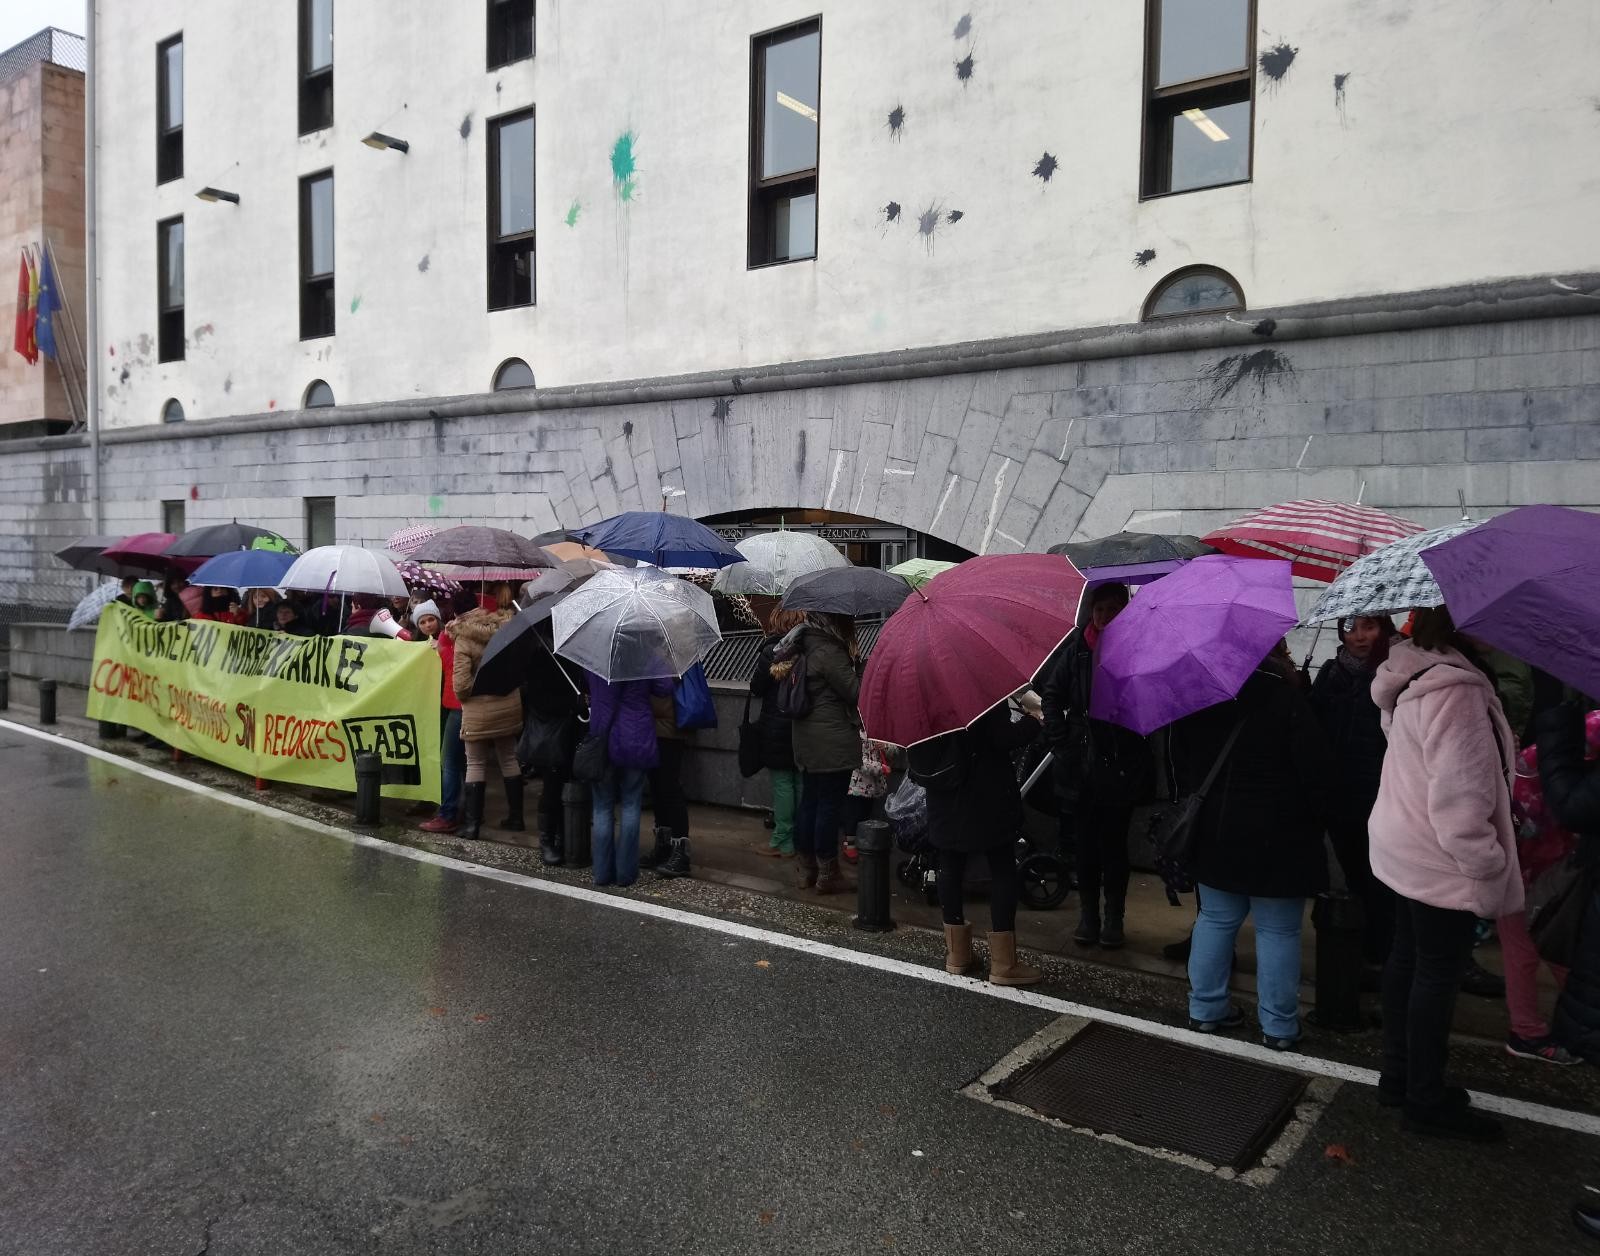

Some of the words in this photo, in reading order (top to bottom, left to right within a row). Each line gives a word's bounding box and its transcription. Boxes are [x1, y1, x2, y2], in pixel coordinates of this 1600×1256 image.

[816, 529, 867, 538] HEZKUNTZA
[335, 638, 368, 692] EZ
[264, 712, 346, 763] RECORTES
[350, 720, 414, 760] LAB
